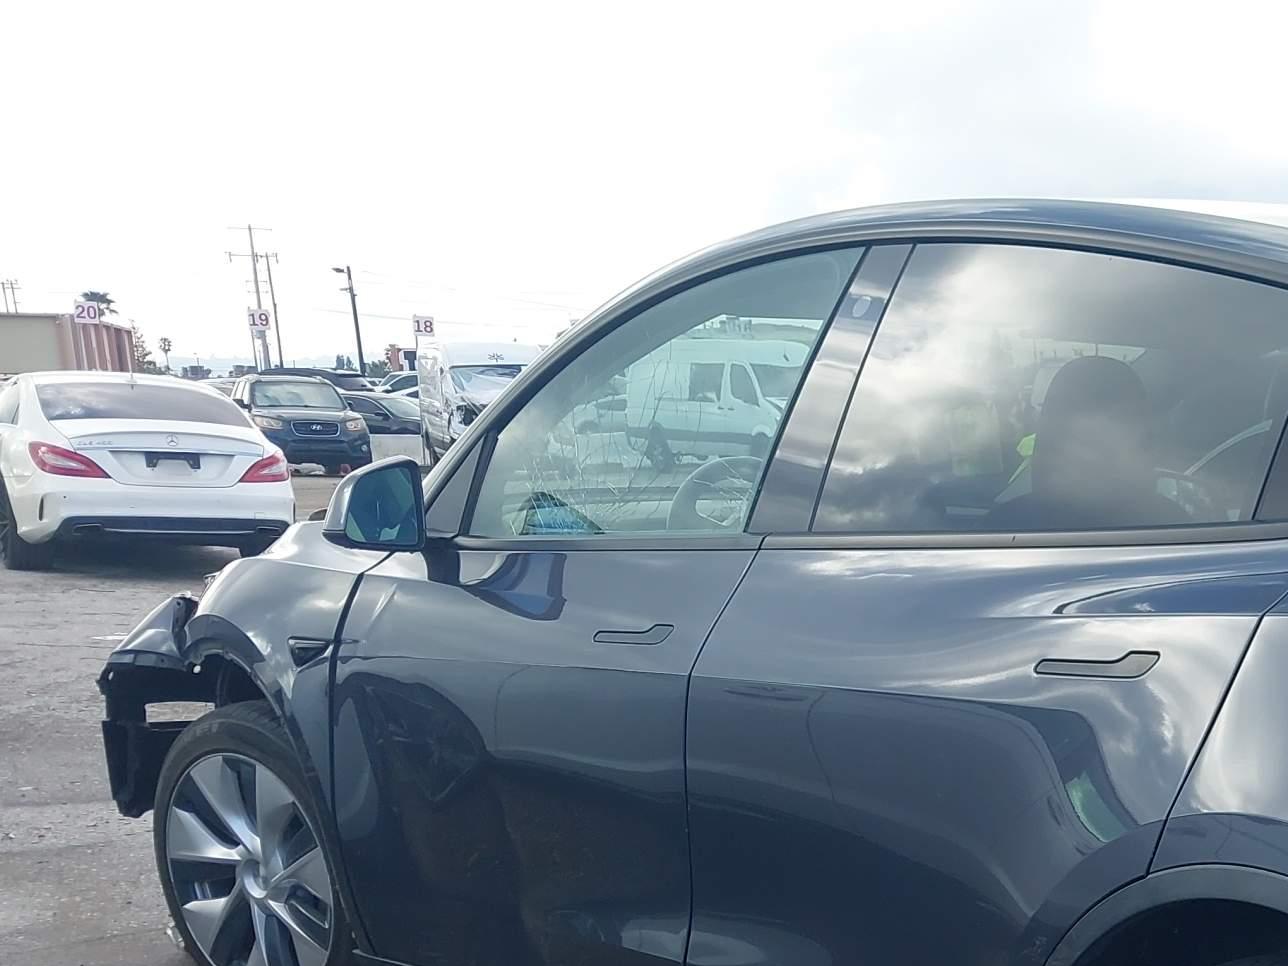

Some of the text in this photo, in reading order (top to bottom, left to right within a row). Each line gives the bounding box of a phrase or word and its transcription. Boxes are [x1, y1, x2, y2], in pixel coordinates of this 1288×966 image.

[75, 304, 97, 320] 20
[248, 312, 269, 327] 19
[414, 319, 433, 333] 18
